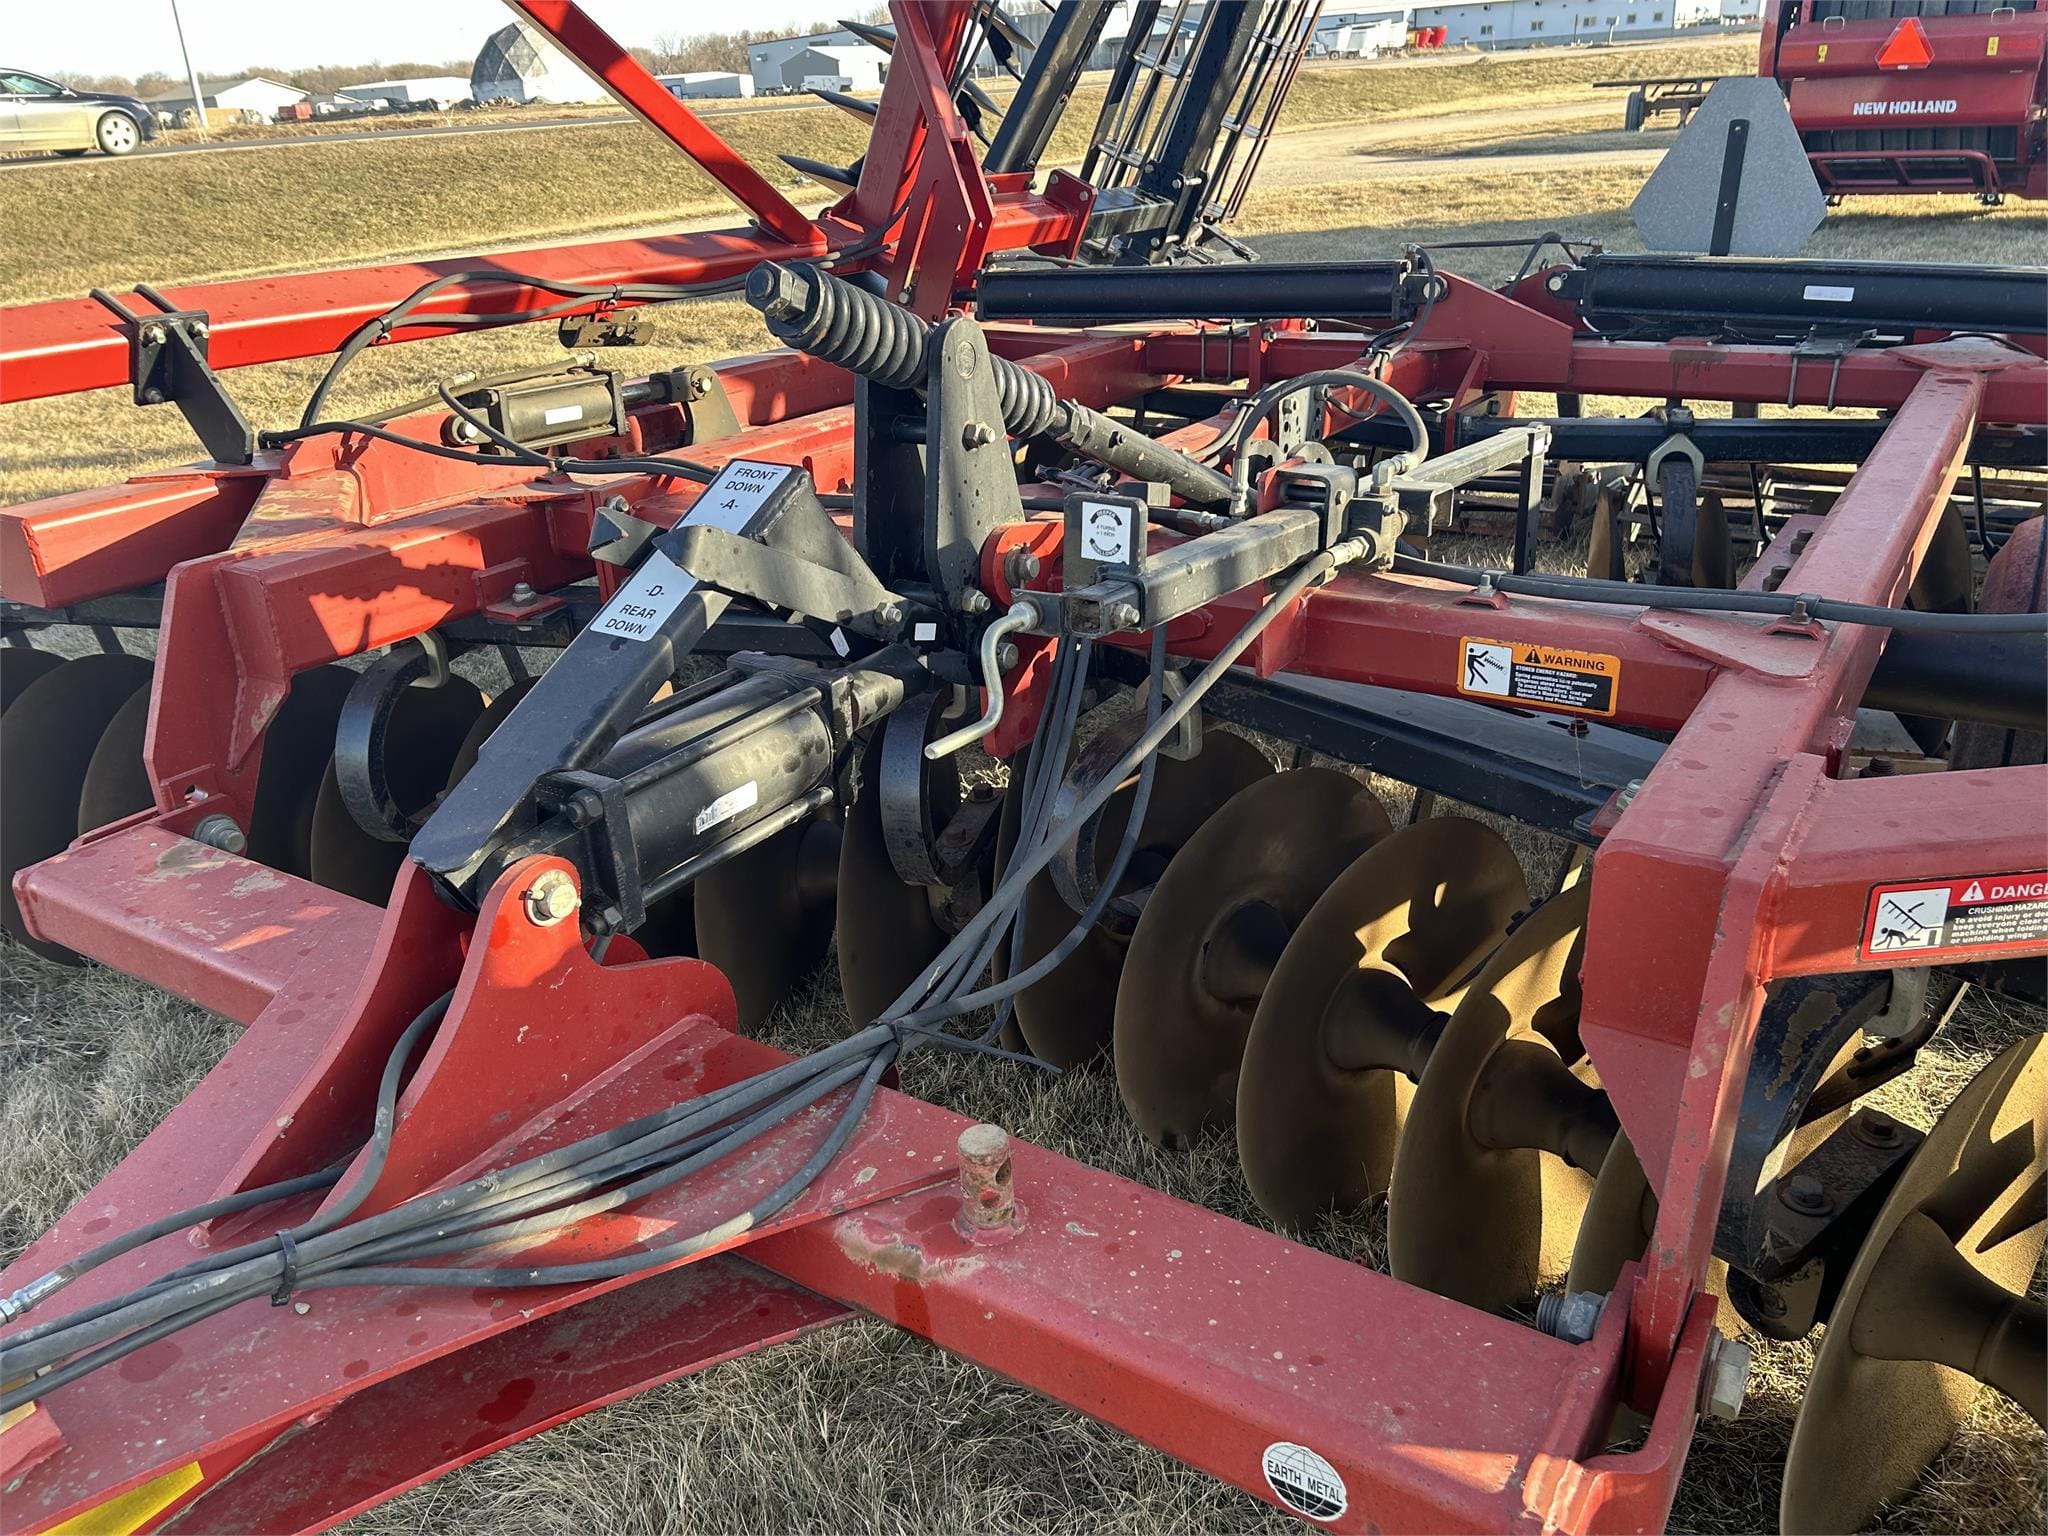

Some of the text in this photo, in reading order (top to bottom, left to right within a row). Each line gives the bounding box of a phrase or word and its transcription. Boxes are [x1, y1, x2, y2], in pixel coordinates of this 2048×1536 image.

[1853, 100, 1957, 115] NEW HOLLAND
[734, 468, 778, 481] FRONT
[725, 481, 765, 494] DOWN
[619, 604, 656, 619] REAR
[605, 618, 646, 635] DOWN
[1544, 654, 1605, 671] WARNING
[1968, 904, 2013, 915] CRUSHING
[1968, 915, 1993, 923] avoid
[1995, 913, 2020, 922] injury
[1976, 920, 2017, 929] everyone
[1951, 924, 2048, 938] machine when folding
[1963, 934, 2006, 943] unfolding
[2007, 932, 2036, 940] wings.
[1267, 1460, 1343, 1504] EARTH METAL
